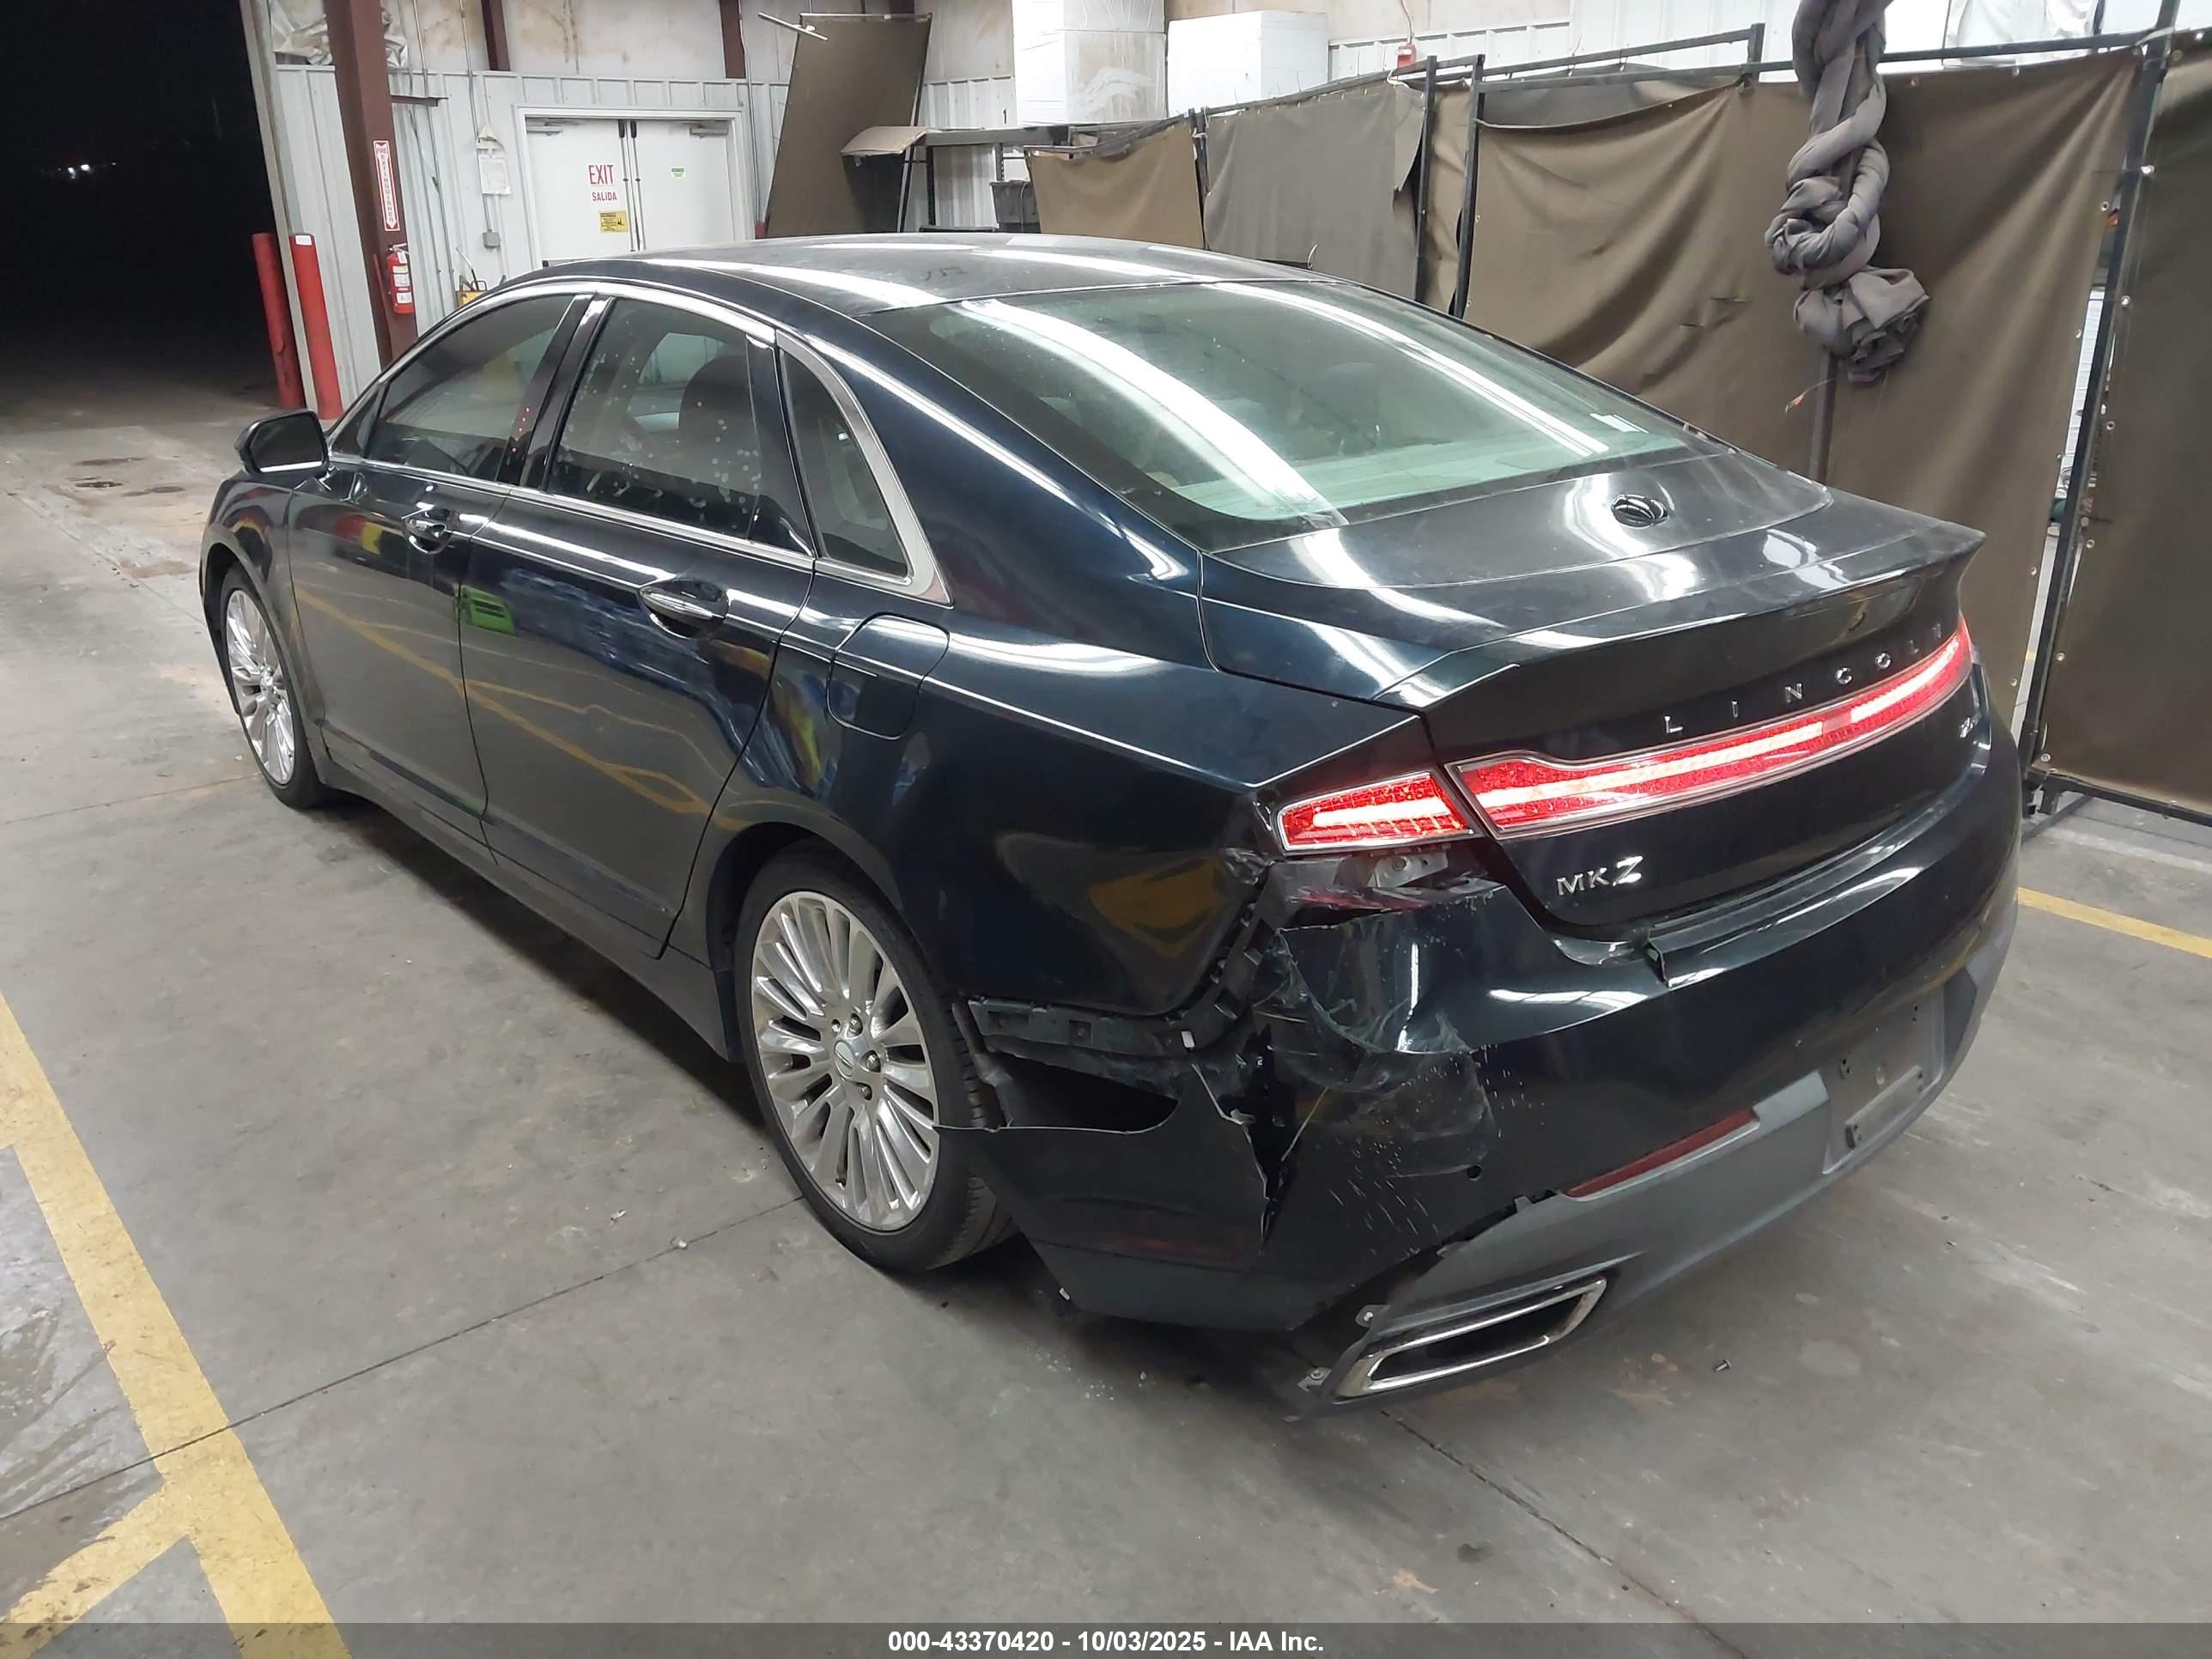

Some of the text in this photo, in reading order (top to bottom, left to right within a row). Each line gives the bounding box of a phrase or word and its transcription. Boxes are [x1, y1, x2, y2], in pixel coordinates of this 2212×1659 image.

[588, 165, 614, 185] EXIT
[592, 191, 617, 202] SALIDA
[1664, 623, 1942, 734] LINCOLN
[1556, 855, 1644, 896] MKZ
